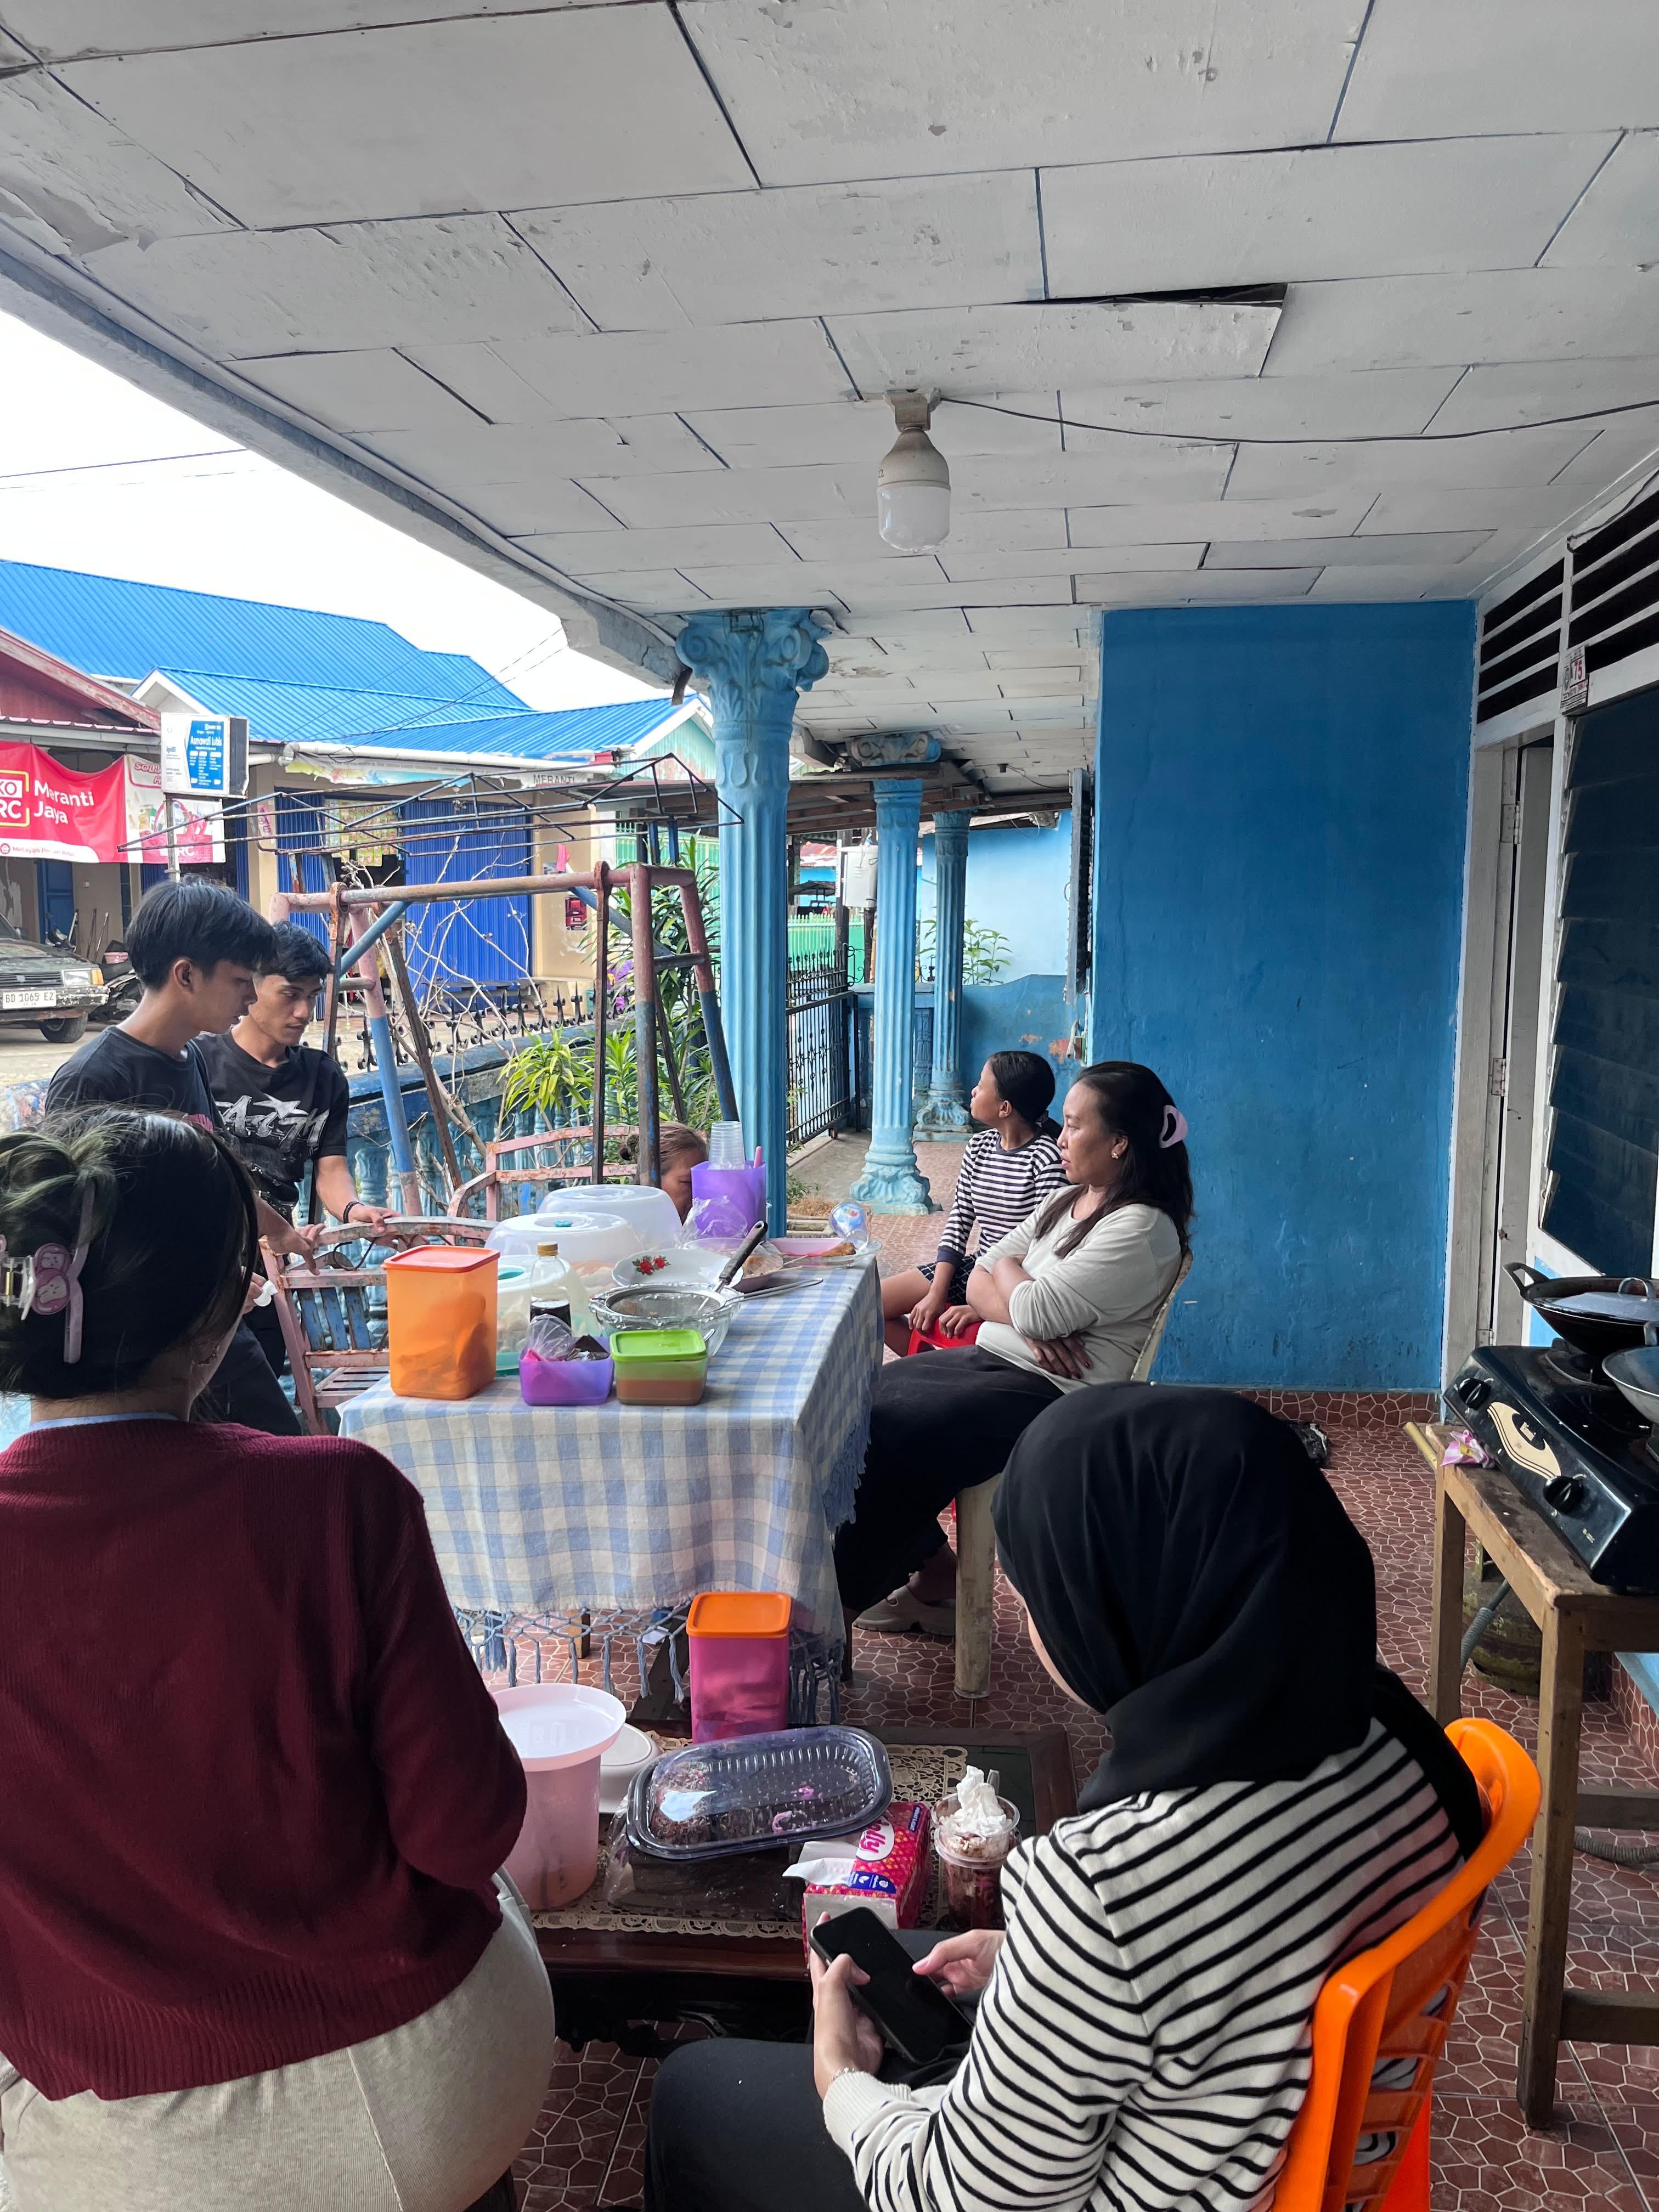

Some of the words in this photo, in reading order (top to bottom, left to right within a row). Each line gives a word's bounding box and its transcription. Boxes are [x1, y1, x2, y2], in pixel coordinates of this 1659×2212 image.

[34, 780, 94, 806] Meranti
[33, 801, 69, 825] Jaya
[5, 994, 15, 1003] BD
[44, 992, 54, 1001] EZ
